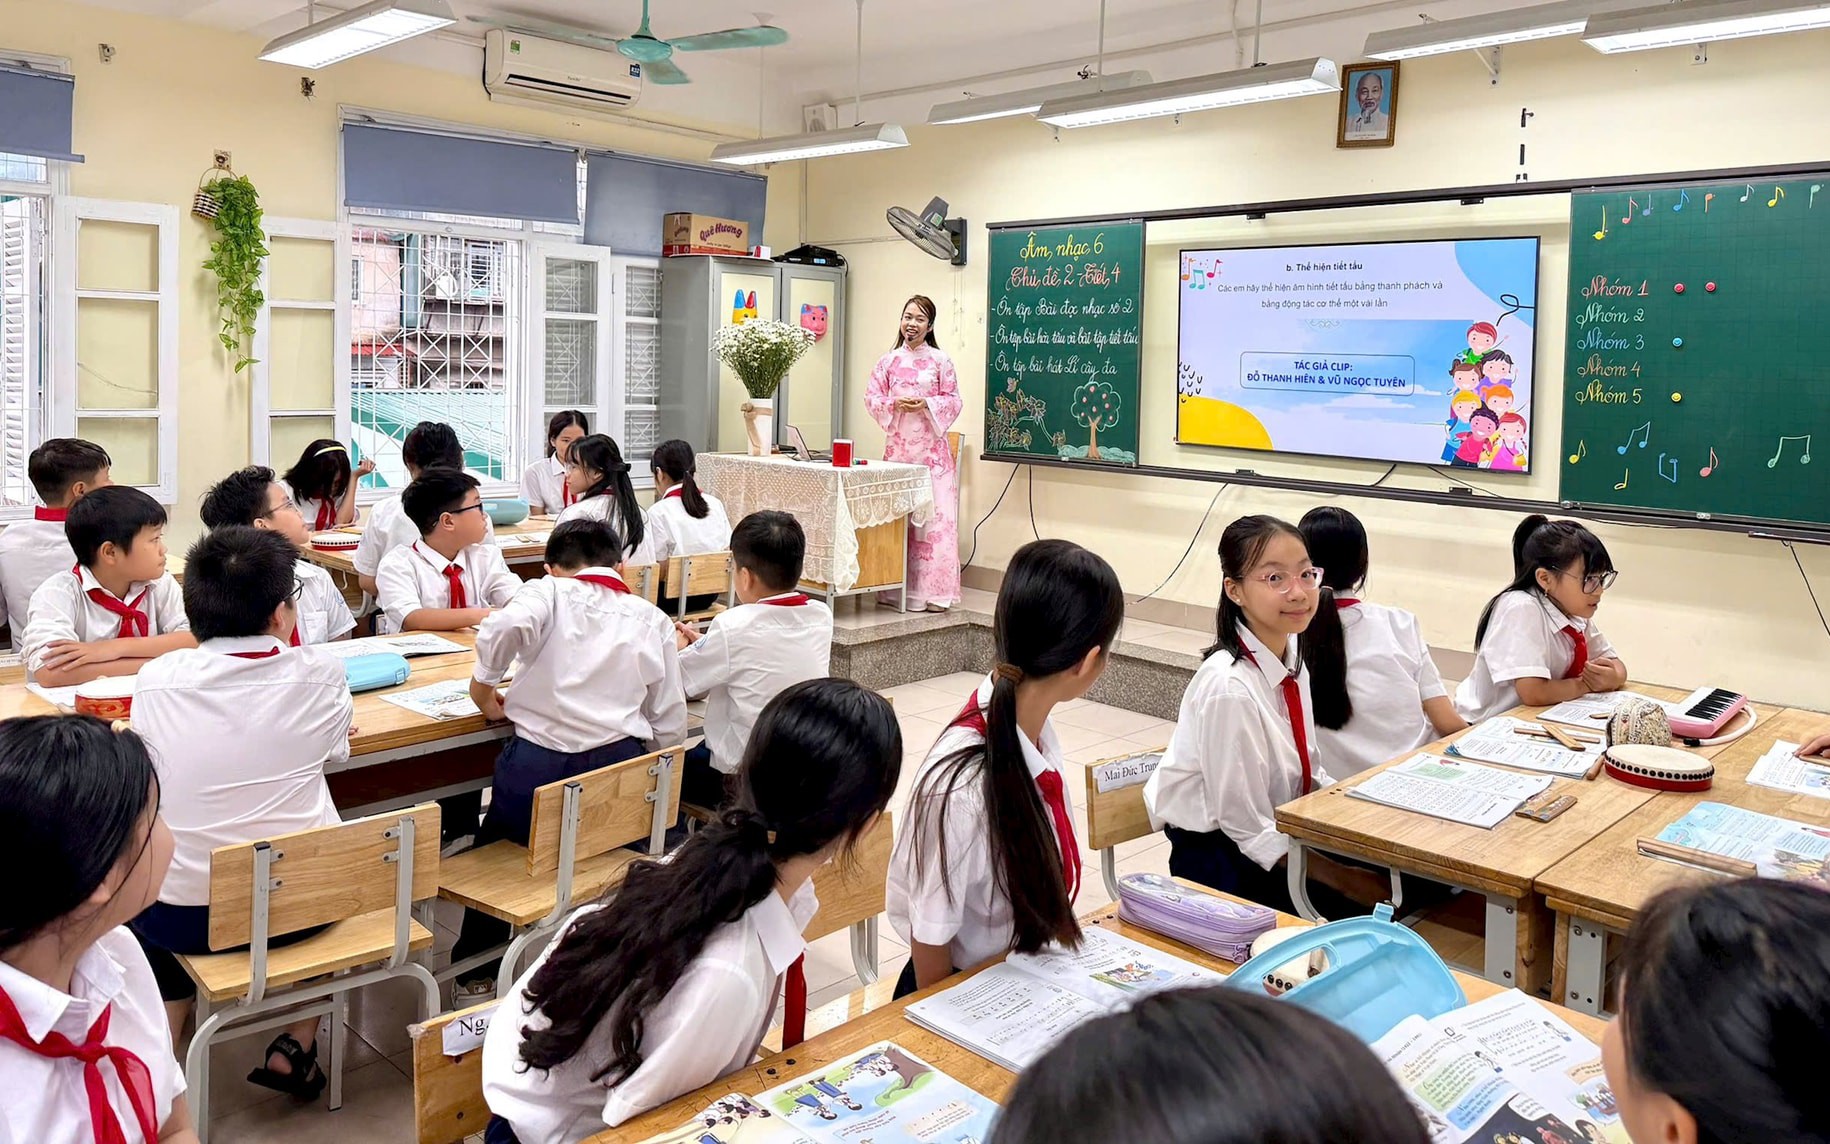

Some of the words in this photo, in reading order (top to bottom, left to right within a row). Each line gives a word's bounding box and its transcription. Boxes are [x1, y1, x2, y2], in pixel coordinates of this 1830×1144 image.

[700, 226, 715, 241] Quê
[715, 223, 743, 238] Hương
[1020, 231, 1053, 262] Âm
[1056, 234, 1090, 261] nhạc
[1094, 233, 1105, 254] 6
[1286, 263, 1294, 272] b.
[1296, 261, 1311, 271] Thể
[1313, 262, 1331, 272] hiện
[1333, 260, 1347, 271] tiết
[1349, 260, 1363, 270] tấu
[1006, 266, 1041, 291] Chủ
[1042, 265, 1061, 287] đề
[1064, 264, 1075, 285] 2
[1079, 262, 1110, 289] Tiết
[1111, 262, 1121, 283] 4
[1217, 284, 1232, 293] Các
[1246, 284, 1259, 294] hãy
[1261, 282, 1273, 292] thể
[1274, 283, 1291, 293] hiện
[1293, 283, 1305, 291] âm
[1307, 283, 1324, 291] hình
[1326, 281, 1338, 291] tiết
[1340, 281, 1353, 291] tấu
[1354, 280, 1375, 292] bằng
[1377, 282, 1401, 290] thanh
[1403, 281, 1430, 291] phách
[1433, 280, 1443, 289] và
[1581, 275, 1633, 300] Nhóm
[1637, 279, 1649, 296] 1
[1035, 297, 1057, 316] Bài
[1060, 299, 1078, 318] đọc
[1082, 298, 1105, 319] nhạc
[1108, 298, 1121, 315] số
[1122, 298, 1134, 314] 2
[1282, 299, 1301, 309] động
[1303, 300, 1315, 308] tác
[1316, 300, 1327, 308] cơ
[1329, 298, 1341, 308] thể
[1343, 299, 1359, 308] một
[1361, 299, 1373, 307] vài
[1375, 297, 1388, 307] lần
[1576, 302, 1630, 330] Nhóm
[1633, 308, 1645, 322] 2
[1577, 326, 1630, 351] Nhóm
[1635, 333, 1645, 350] 3
[1029, 355, 1044, 372] bài
[1046, 355, 1063, 374] hát
[1101, 357, 1118, 374] đa
[1294, 359, 1310, 370] TÁC
[1312, 359, 1329, 371] GIẢ
[1331, 362, 1353, 372] CLIP:
[1577, 353, 1628, 378] Nhóm
[1631, 361, 1641, 378] 4
[1247, 370, 1260, 382] ĐỖ
[1262, 373, 1292, 383] THANH
[1317, 375, 1325, 384] &
[1327, 374, 1341, 385] VŨ
[1343, 376, 1371, 387] NGỌC
[1575, 379, 1629, 405] Nhóm
[1632, 388, 1643, 404] 5
[1104, 768, 1120, 781] Mai
[1122, 766, 1138, 778] Đức
